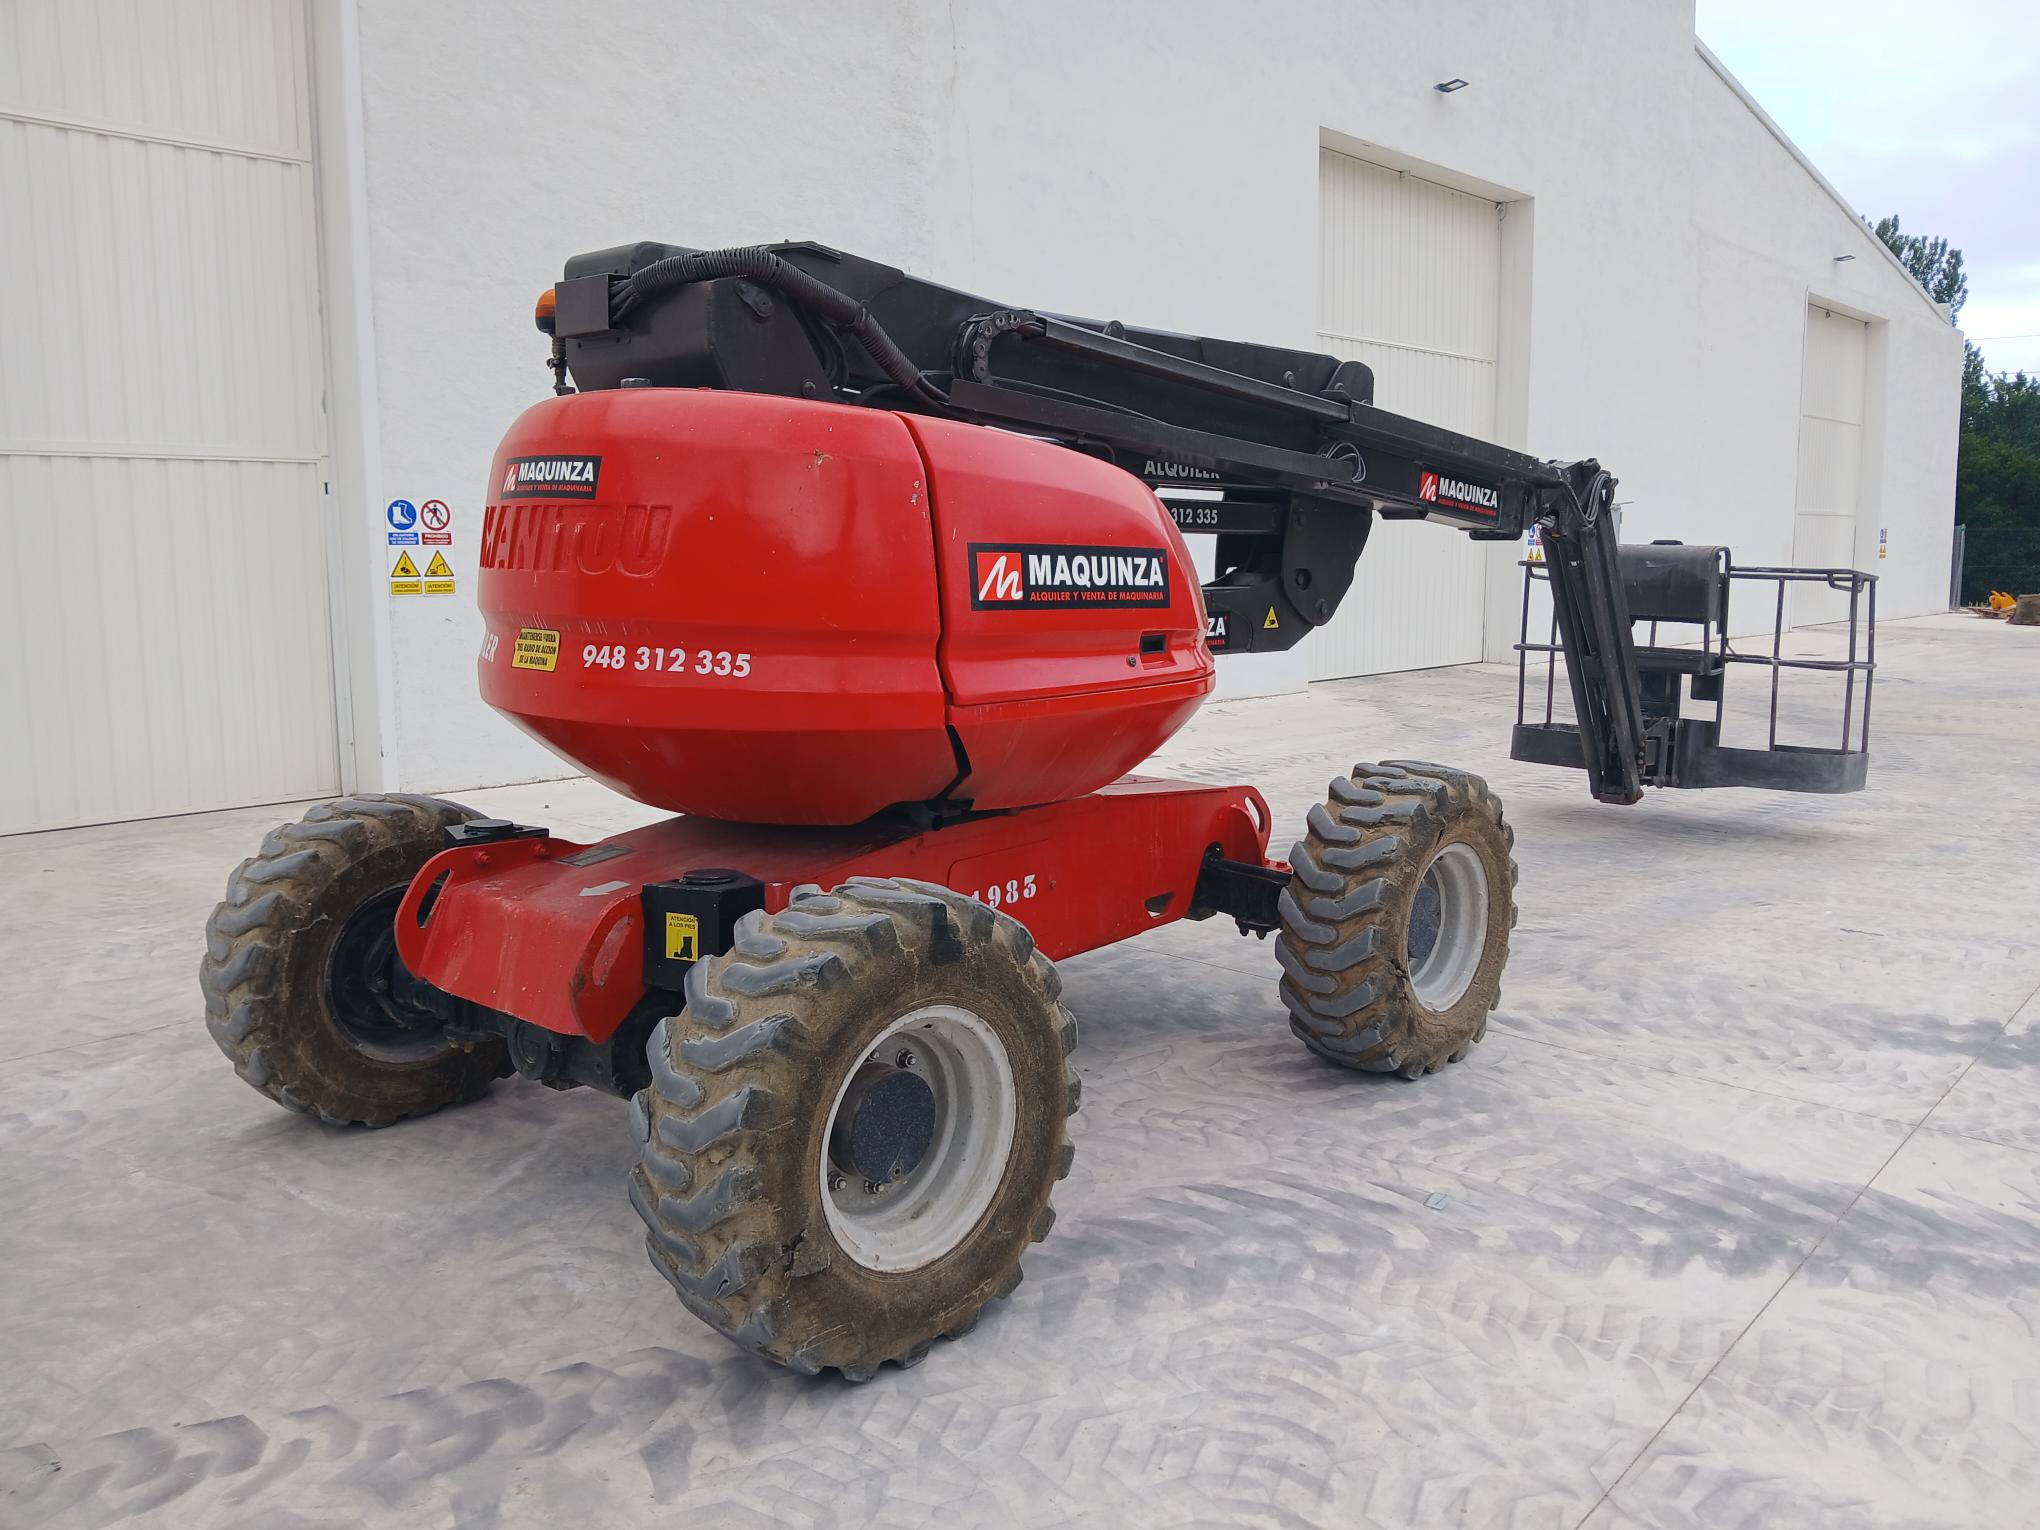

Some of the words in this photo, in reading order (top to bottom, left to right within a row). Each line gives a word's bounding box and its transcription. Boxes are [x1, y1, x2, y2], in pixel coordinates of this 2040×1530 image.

[518, 461, 595, 481] MAQUINZA
[1438, 477, 1498, 508] MAQUINZA
[1171, 508, 1193, 523] 312
[1196, 508, 1218, 524] 335
[480, 500, 672, 577] MANITOU
[1029, 554, 1164, 588] MAQUINZA
[1030, 592, 1070, 601] ALQUILER
[1073, 592, 1079, 600] Y
[1081, 592, 1104, 600] VENTA
[1108, 592, 1117, 600] DE
[1119, 592, 1164, 600] MAQUINARIA
[582, 644, 626, 670] 948
[634, 646, 686, 672] 312
[694, 650, 751, 678] 335
